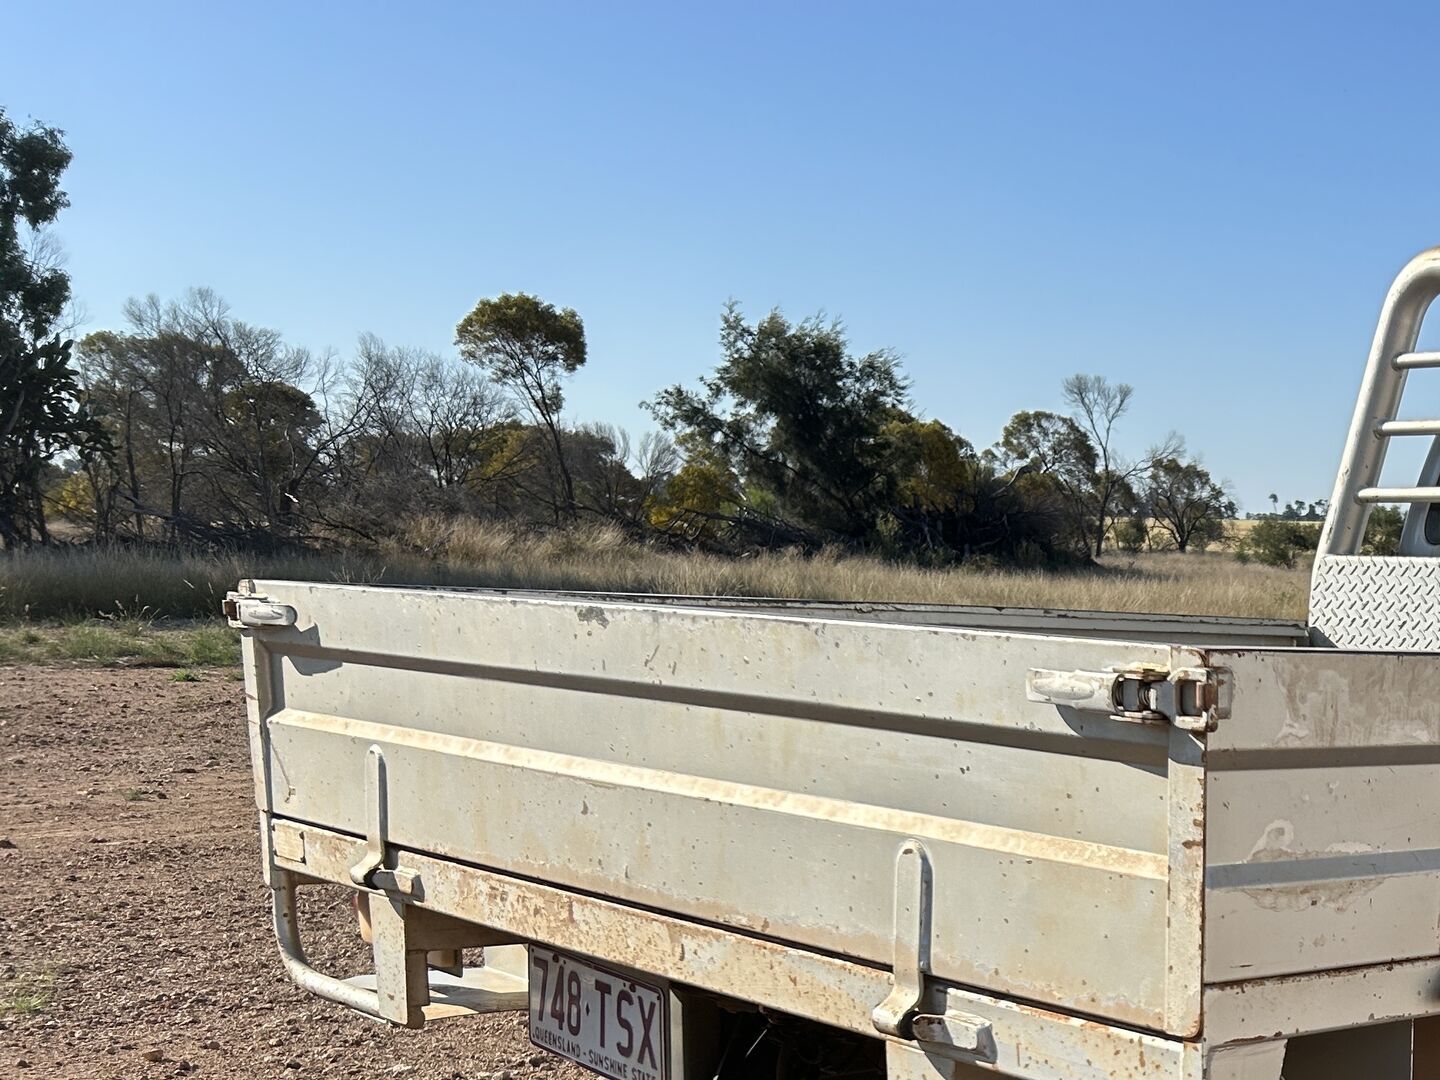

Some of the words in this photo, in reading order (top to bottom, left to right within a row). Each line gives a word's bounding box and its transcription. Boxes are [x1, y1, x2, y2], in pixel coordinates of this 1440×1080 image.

[533, 956, 581, 1037] 748
[595, 979, 657, 1070] TSX
[535, 1026, 581, 1059] QUEENSLAND
[588, 1048, 628, 1079] SUNSHINE
